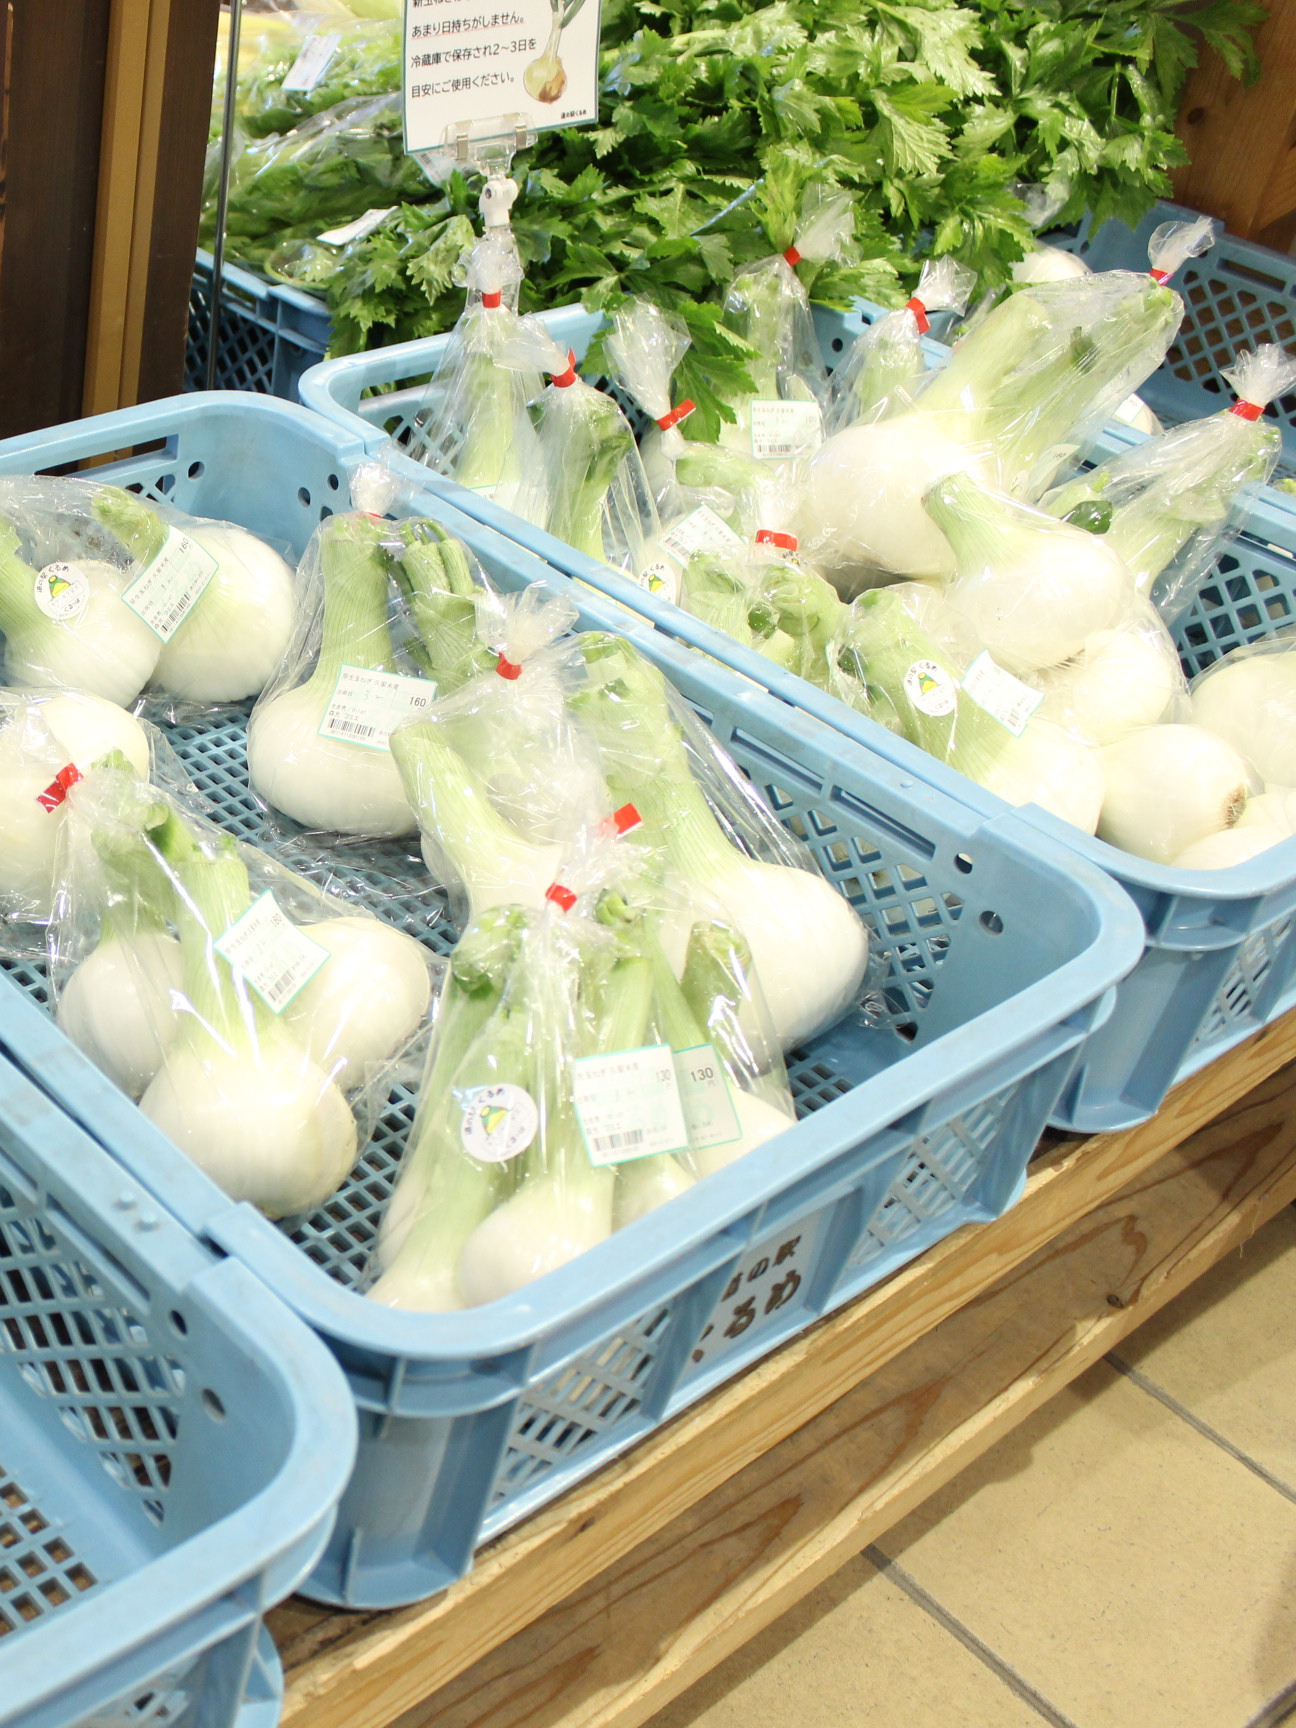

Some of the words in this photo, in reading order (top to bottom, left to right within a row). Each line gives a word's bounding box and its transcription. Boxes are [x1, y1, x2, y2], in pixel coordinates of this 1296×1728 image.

[411, 11, 525, 38] あまり日持ちがしません。
[410, 71, 515, 98] 目安にご使用ください。
[560, 109, 587, 119] 道の駅くるめ
[176, 537, 190, 554] 160
[49, 564, 70, 573] くるめ
[342, 673, 372, 684] 早生玉ねぎ
[408, 695, 427, 708] 160
[655, 1068, 671, 1082] 130
[690, 1066, 715, 1084] 130
